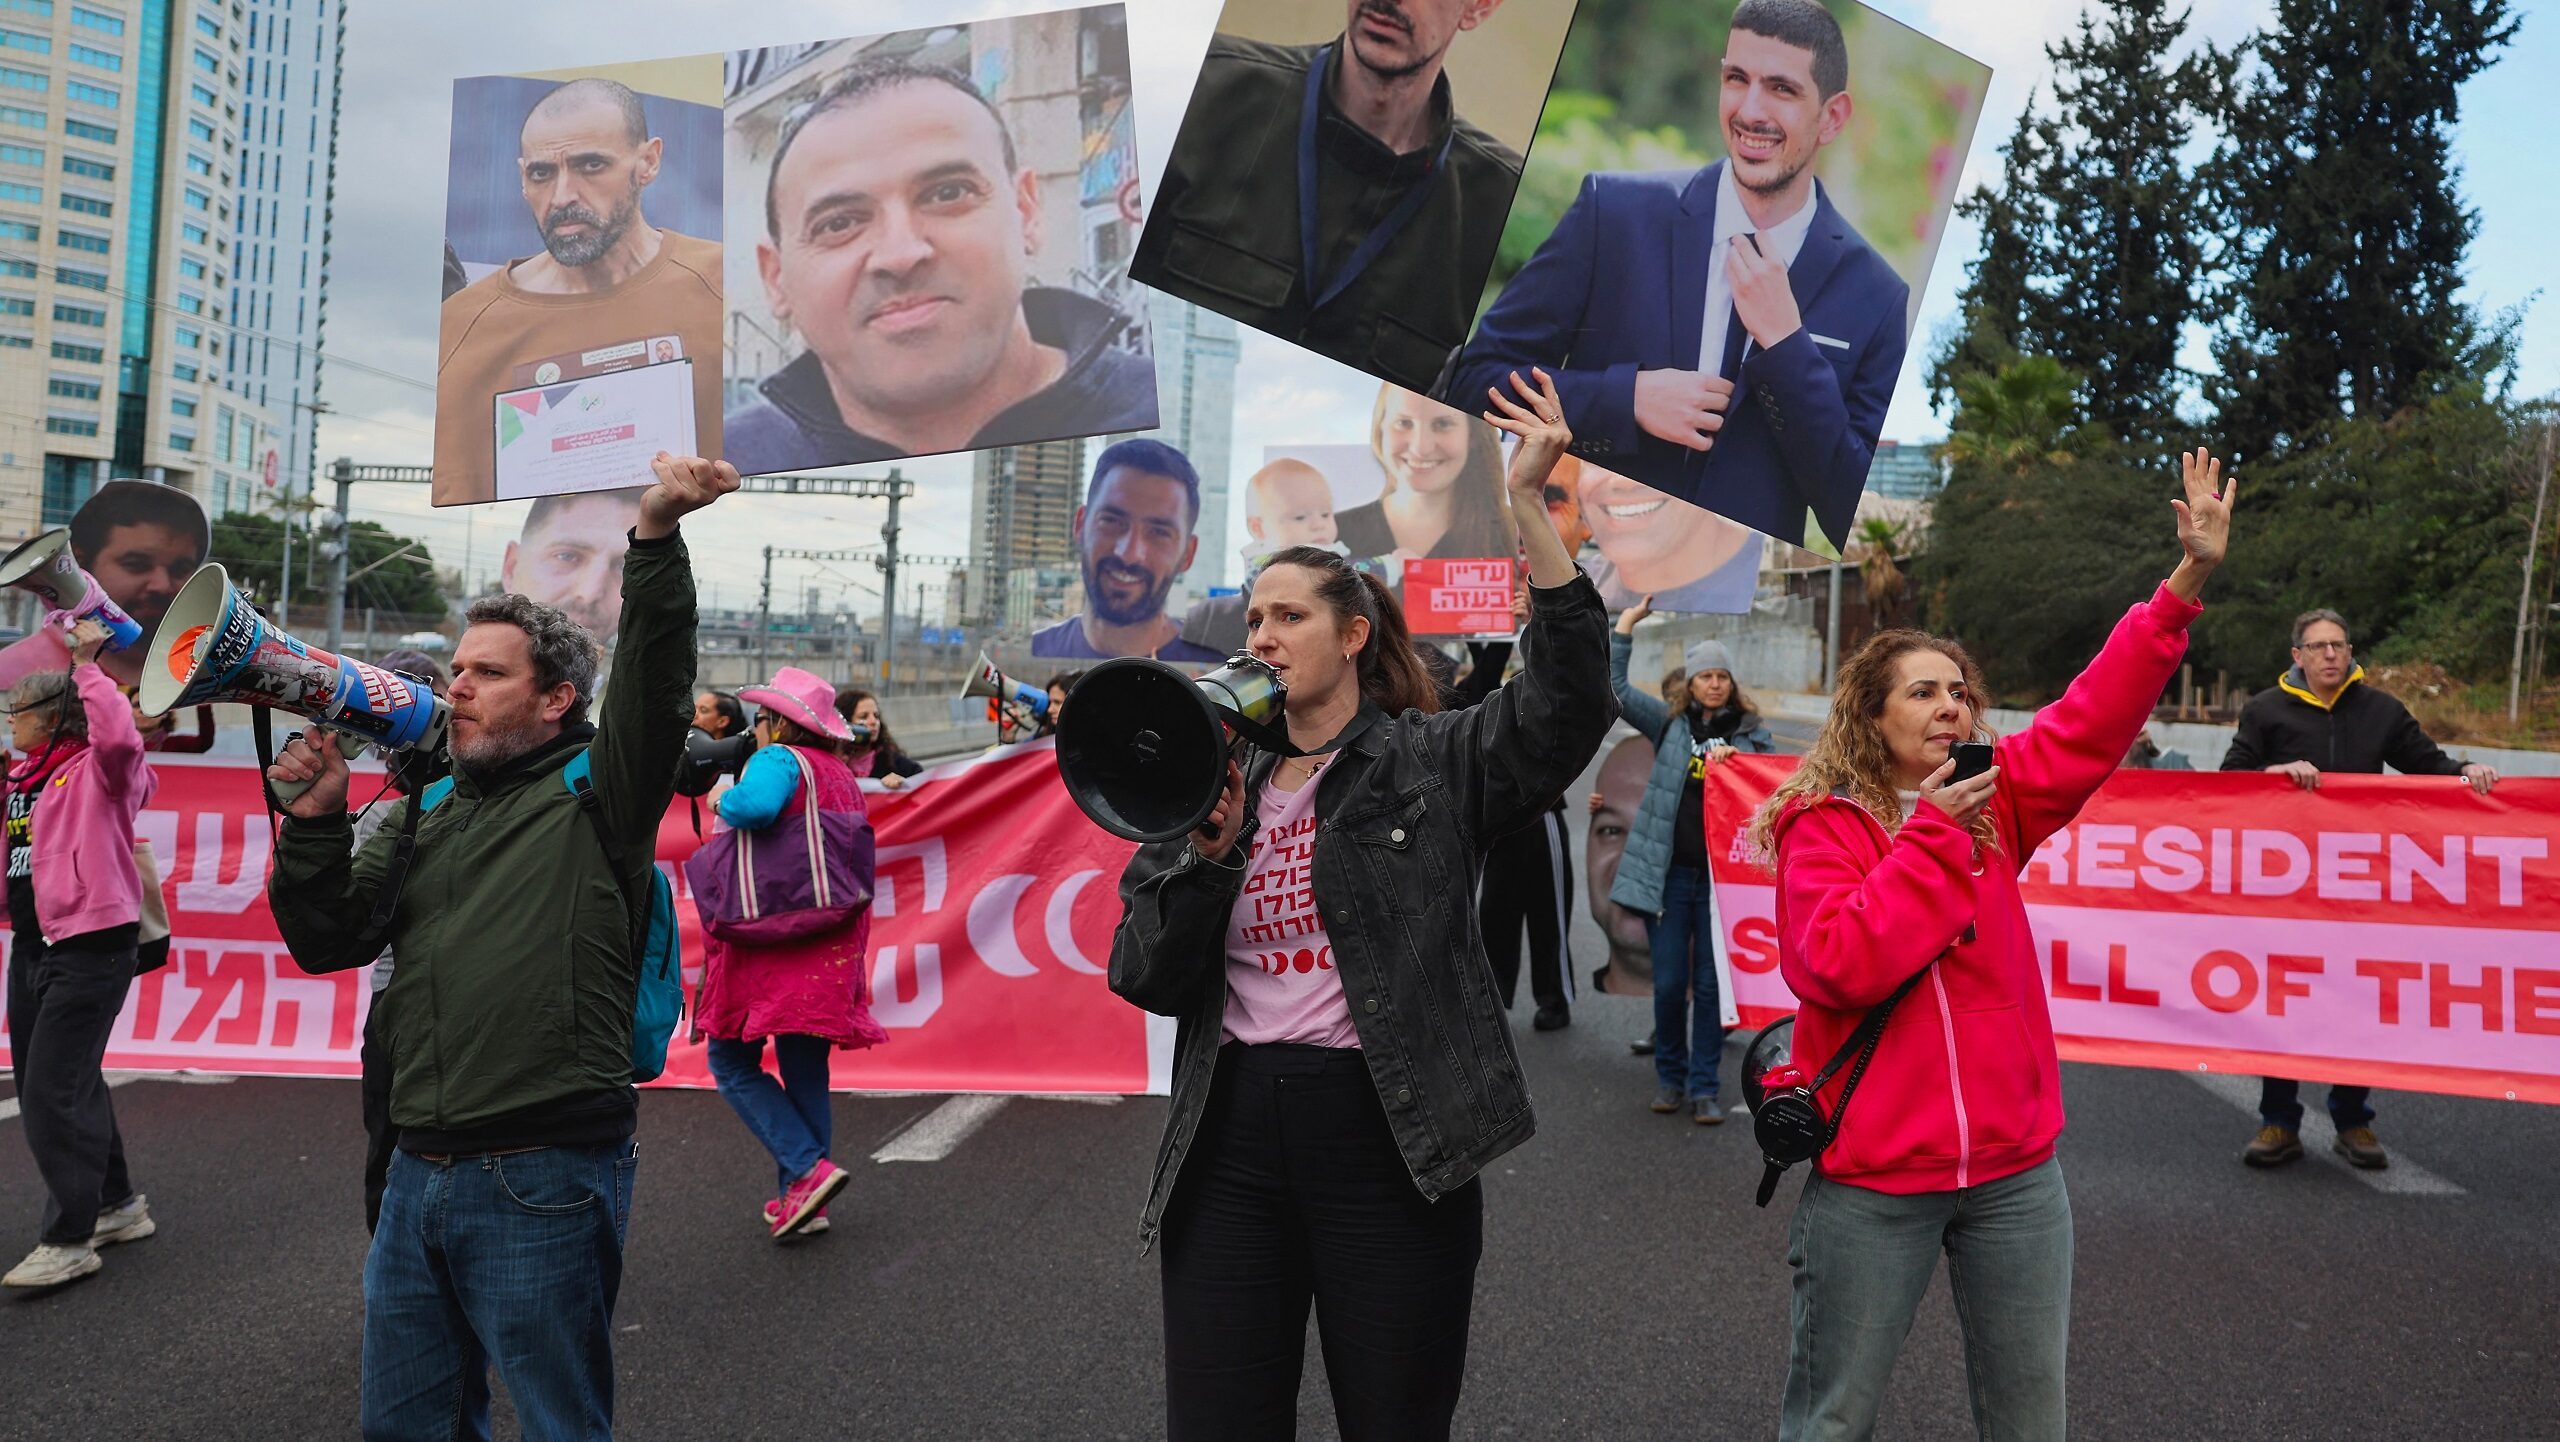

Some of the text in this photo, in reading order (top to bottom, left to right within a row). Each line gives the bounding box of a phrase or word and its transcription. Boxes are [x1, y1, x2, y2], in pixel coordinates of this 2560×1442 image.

[1447, 564, 1506, 586] עדיין
[1433, 591, 1507, 609] בעזה.
[1275, 841, 1314, 863] עד
[2017, 823, 2548, 907] RESIDENT
[1245, 864, 1311, 894] כולם
[1255, 887, 1315, 921] כולן
[2051, 940, 2160, 1007] LL
[2191, 949, 2325, 1016] OF
